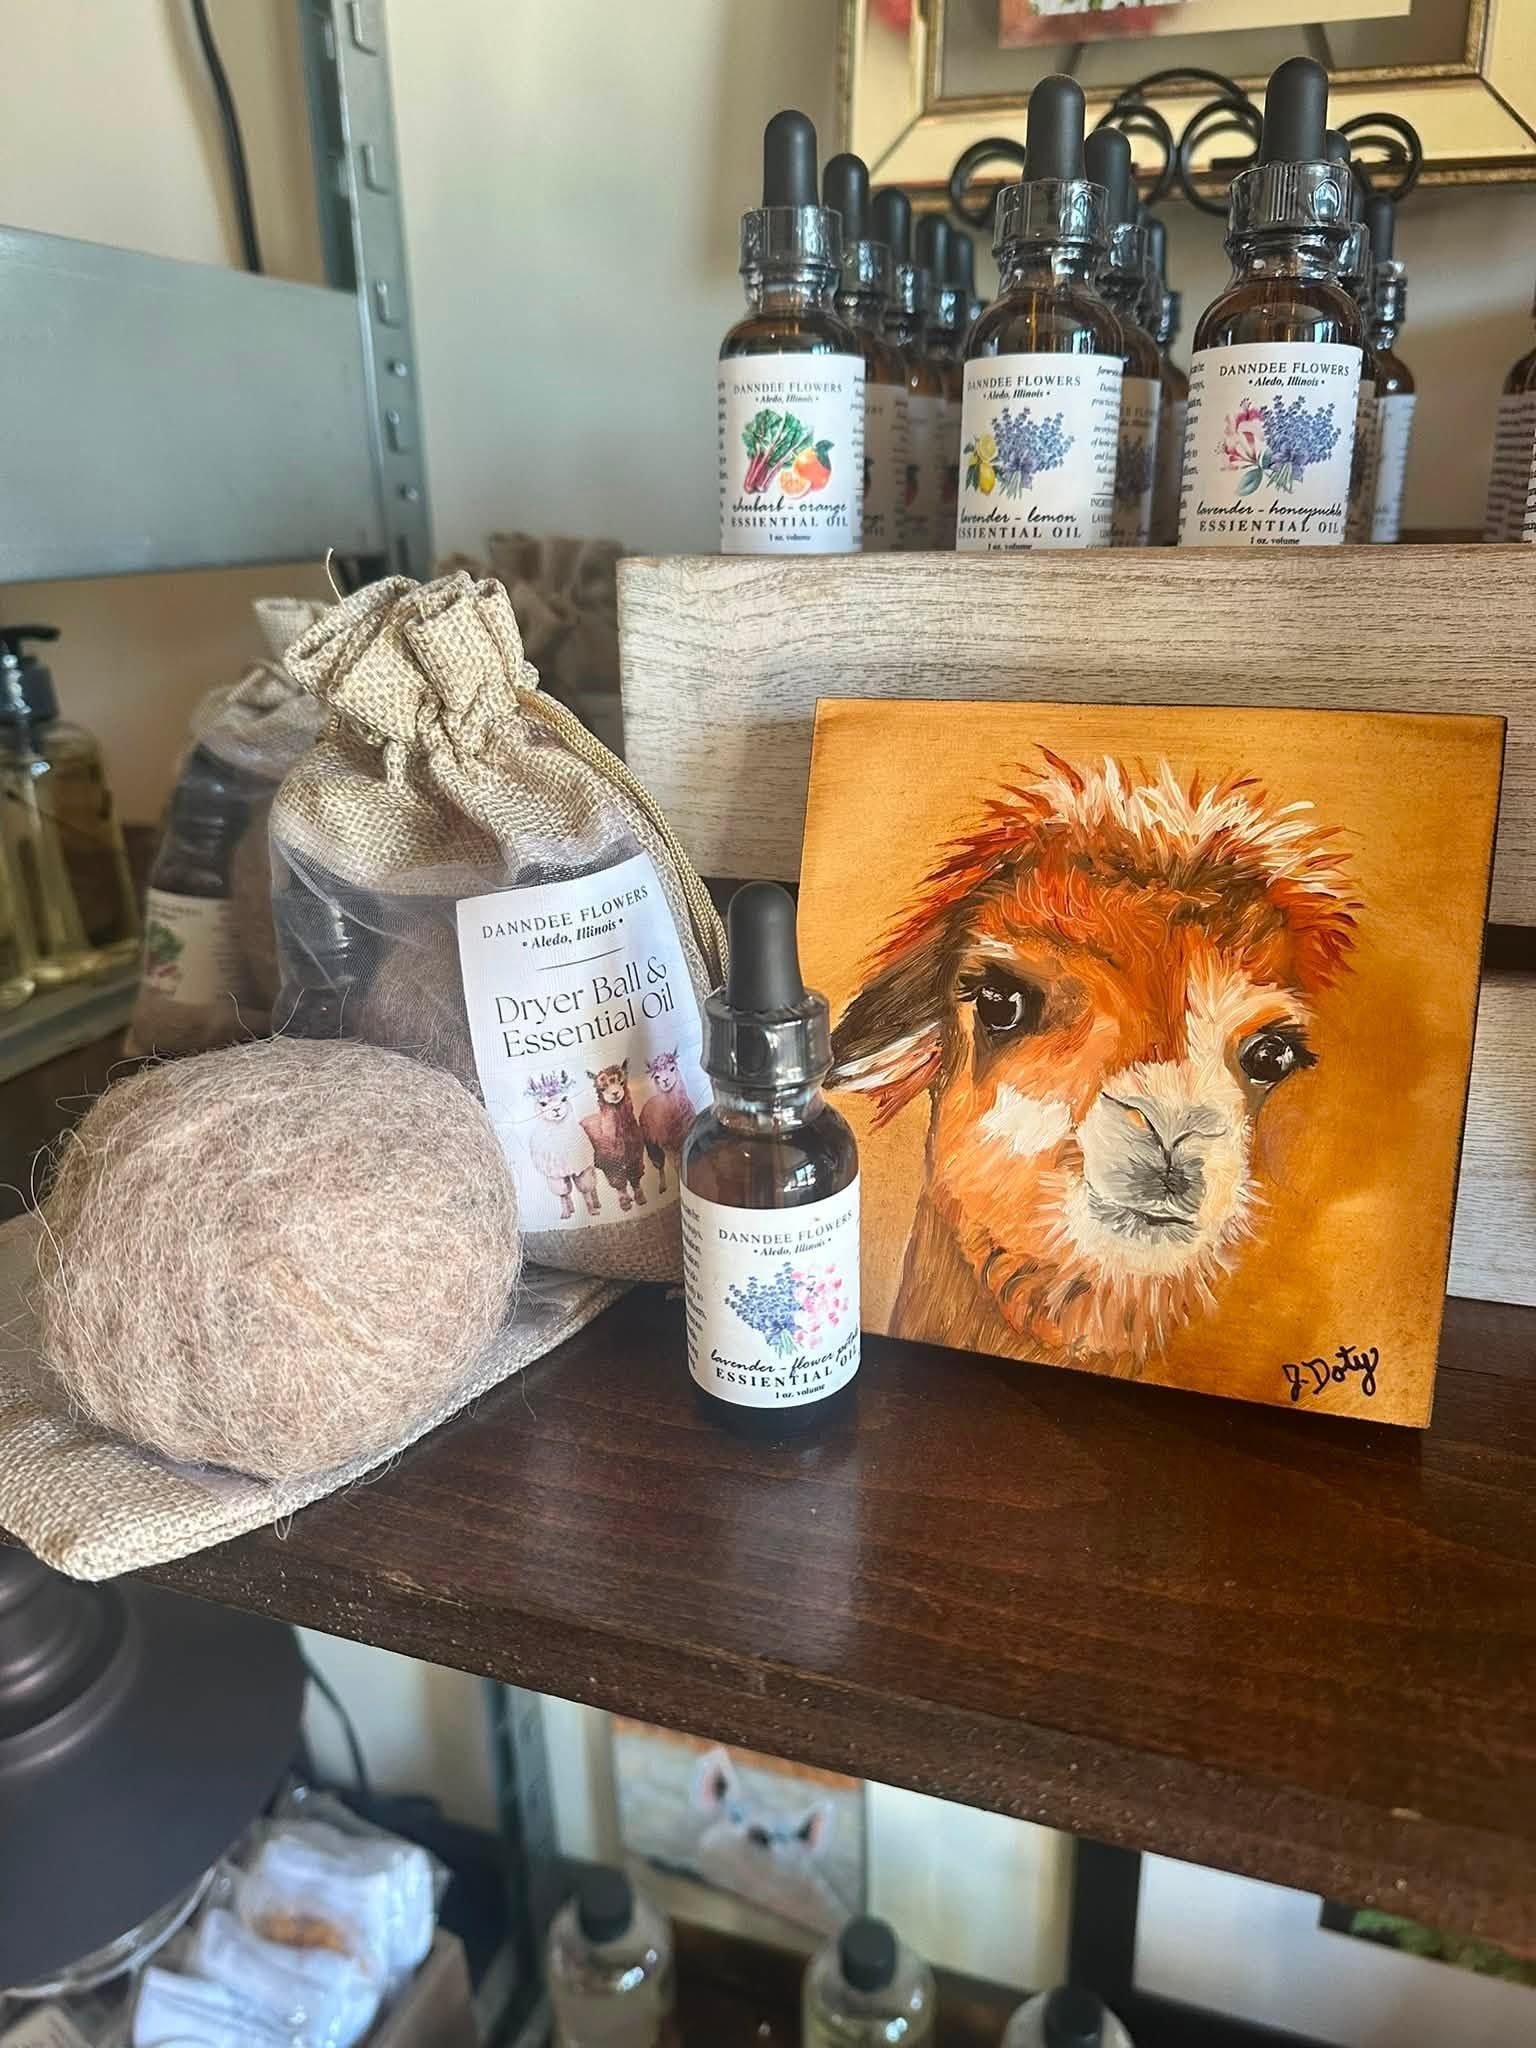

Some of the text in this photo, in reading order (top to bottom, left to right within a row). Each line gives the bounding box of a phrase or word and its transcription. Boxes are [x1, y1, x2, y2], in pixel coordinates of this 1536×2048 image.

[1219, 362, 1349, 377] DANNDEE FLOWERS
[734, 382, 842, 395] DANNDEE FLOWERS
[1017, 375, 1081, 387] FLOWERS
[1254, 376, 1319, 387] Aledo, Illinois
[1013, 389, 1044, 399] Illinois
[733, 496, 784, 512] rhubarb
[799, 503, 847, 520] orange
[1027, 506, 1077, 523] lemon
[1196, 500, 1254, 515] lavender
[827, 515, 849, 528] OIL
[1199, 520, 1339, 534] ESSIENTIAL OIL
[1052, 527, 1082, 538] OIL
[1271, 536, 1300, 545] volume
[482, 885, 649, 939] DANNDEE FLOWERS
[531, 921, 617, 949] Aledo, Illinois
[495, 956, 667, 1025] Dryer Ball &
[502, 981, 675, 1058] Essential Oil
[719, 1210, 852, 1245] DANNDEE FLOWERS
[760, 1246, 792, 1257] Aledo,
[711, 1349, 776, 1373] lavender
[789, 1353, 833, 1379] flower
[716, 1345, 857, 1388] ESSIENTIAL OIL
[1301, 1345, 1379, 1396] Doty
[782, 1391, 794, 1399] oz.
[797, 1383, 826, 1397] volume
